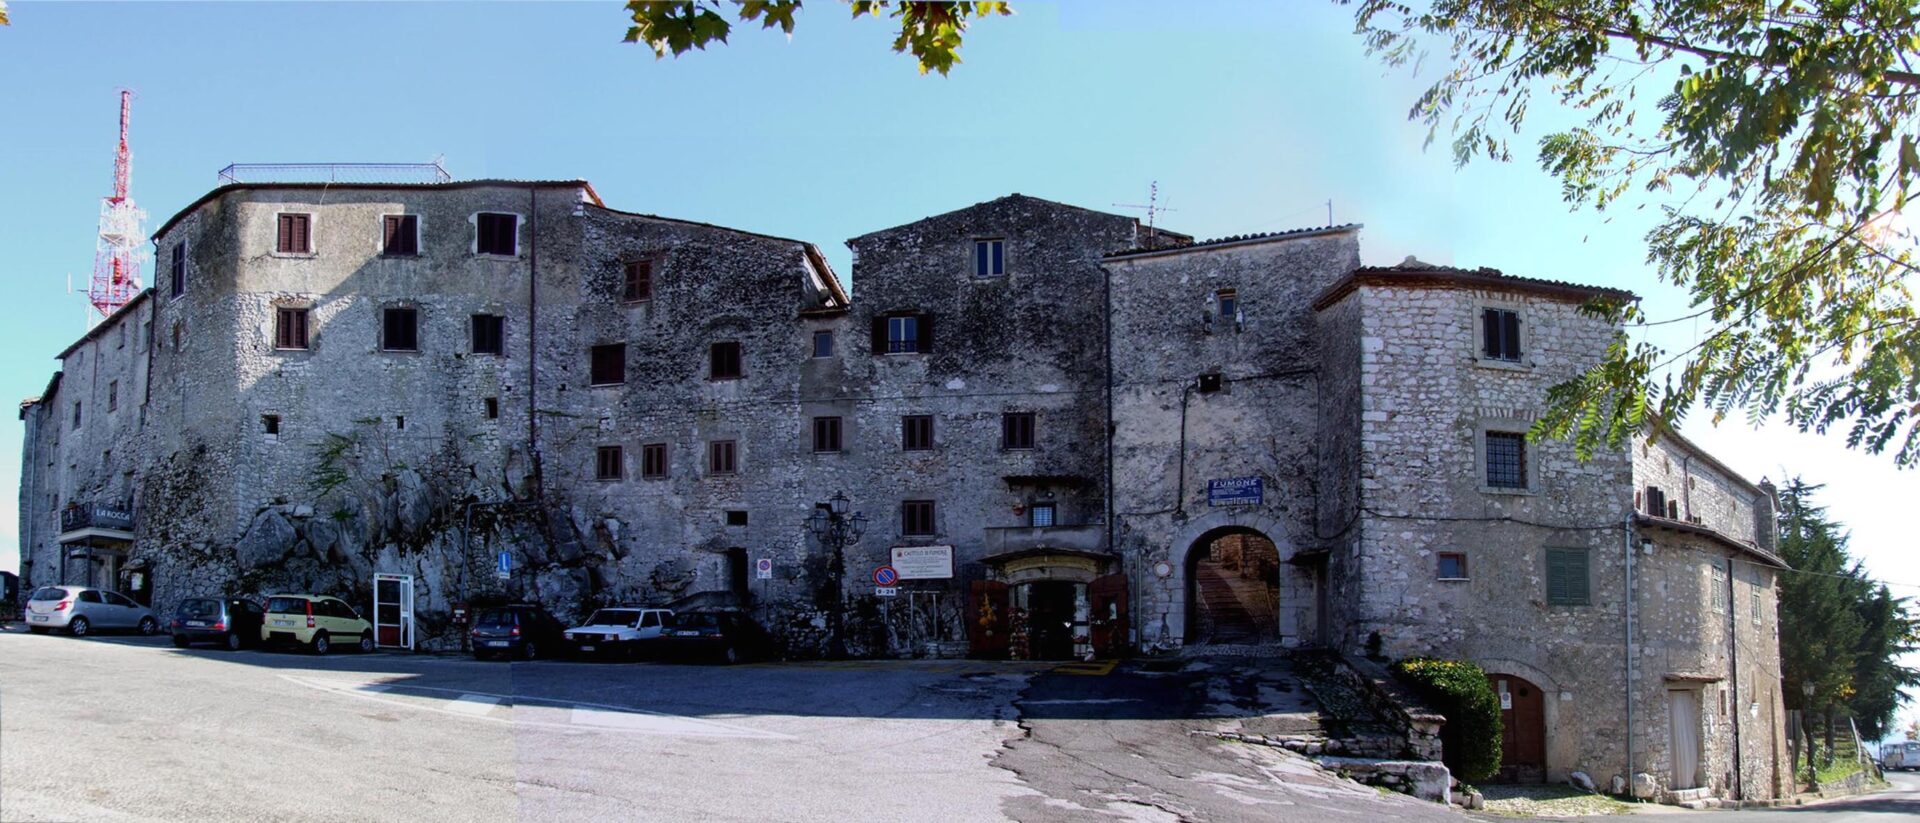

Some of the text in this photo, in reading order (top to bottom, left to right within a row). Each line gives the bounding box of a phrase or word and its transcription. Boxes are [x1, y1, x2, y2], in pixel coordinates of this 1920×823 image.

[1213, 479, 1257, 488] FUMONE
[96, 509, 130, 521] LA ROCCA
